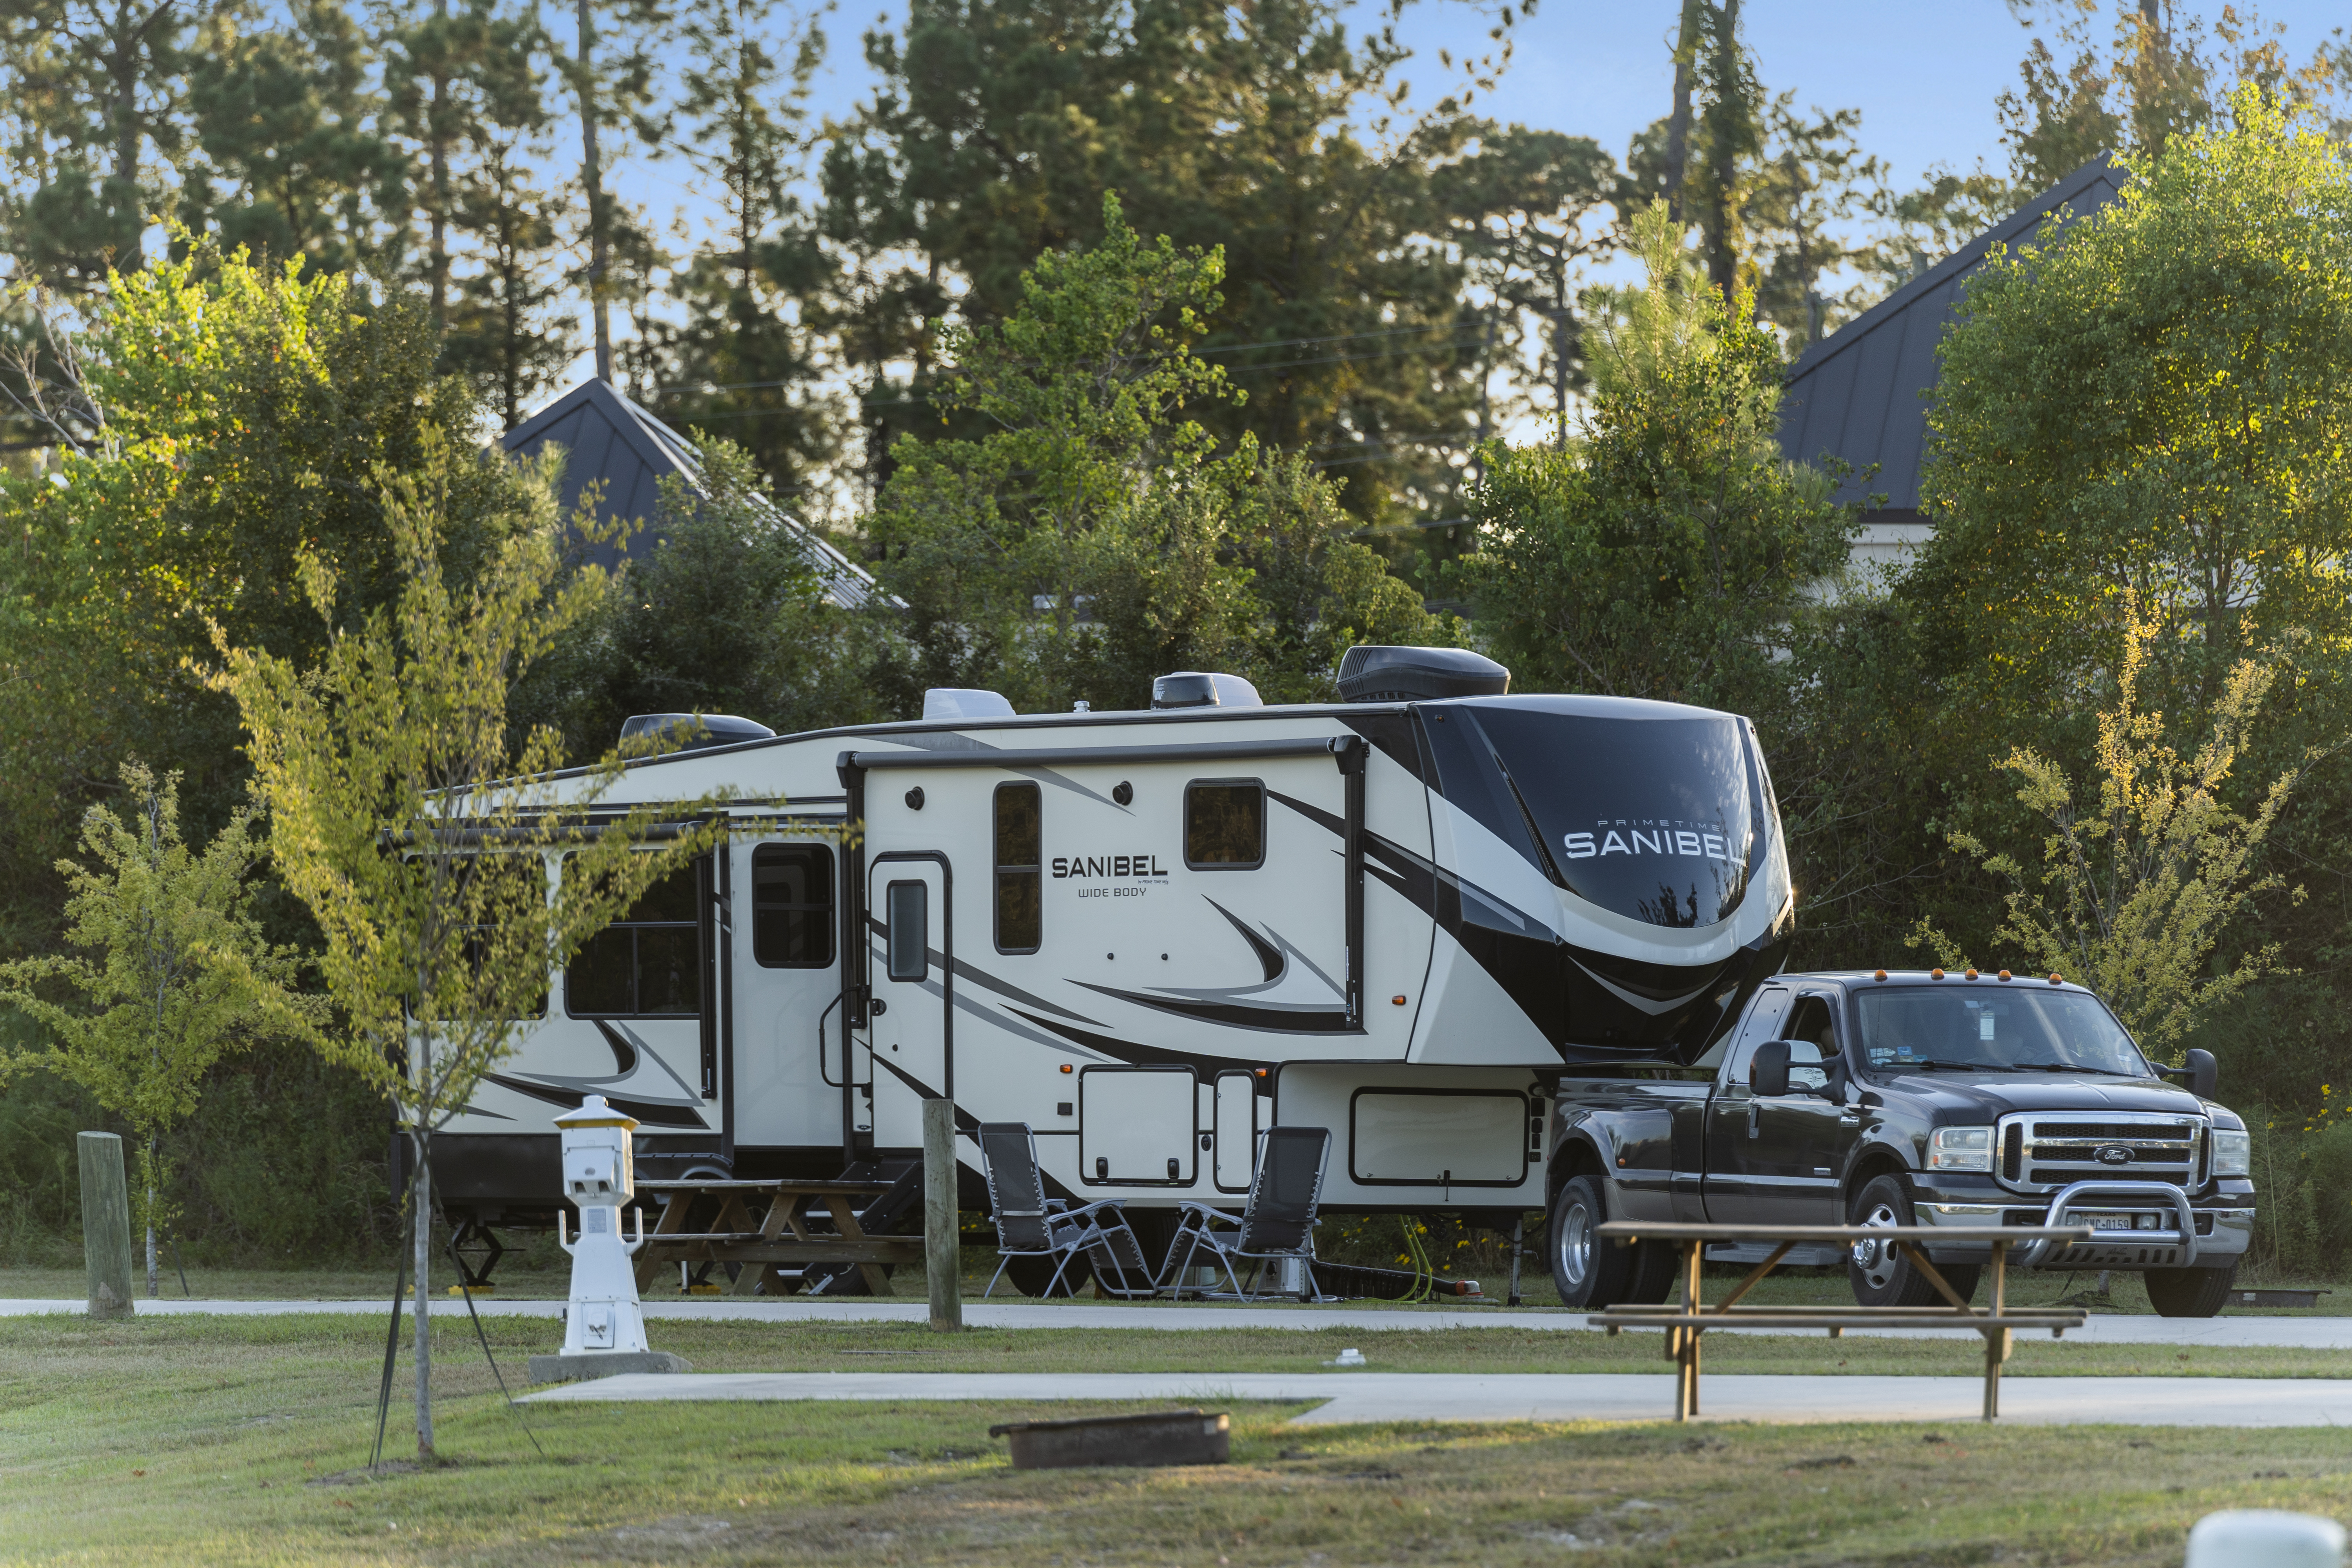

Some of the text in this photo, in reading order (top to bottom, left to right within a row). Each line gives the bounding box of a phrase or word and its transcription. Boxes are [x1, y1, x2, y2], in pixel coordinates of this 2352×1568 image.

[1564, 829, 1746, 867] SANIBEL
[1053, 855, 1168, 878] SANIBEL
[1078, 887, 1146, 897] WIDE BODY
[2105, 1150, 2126, 1159] Ford
